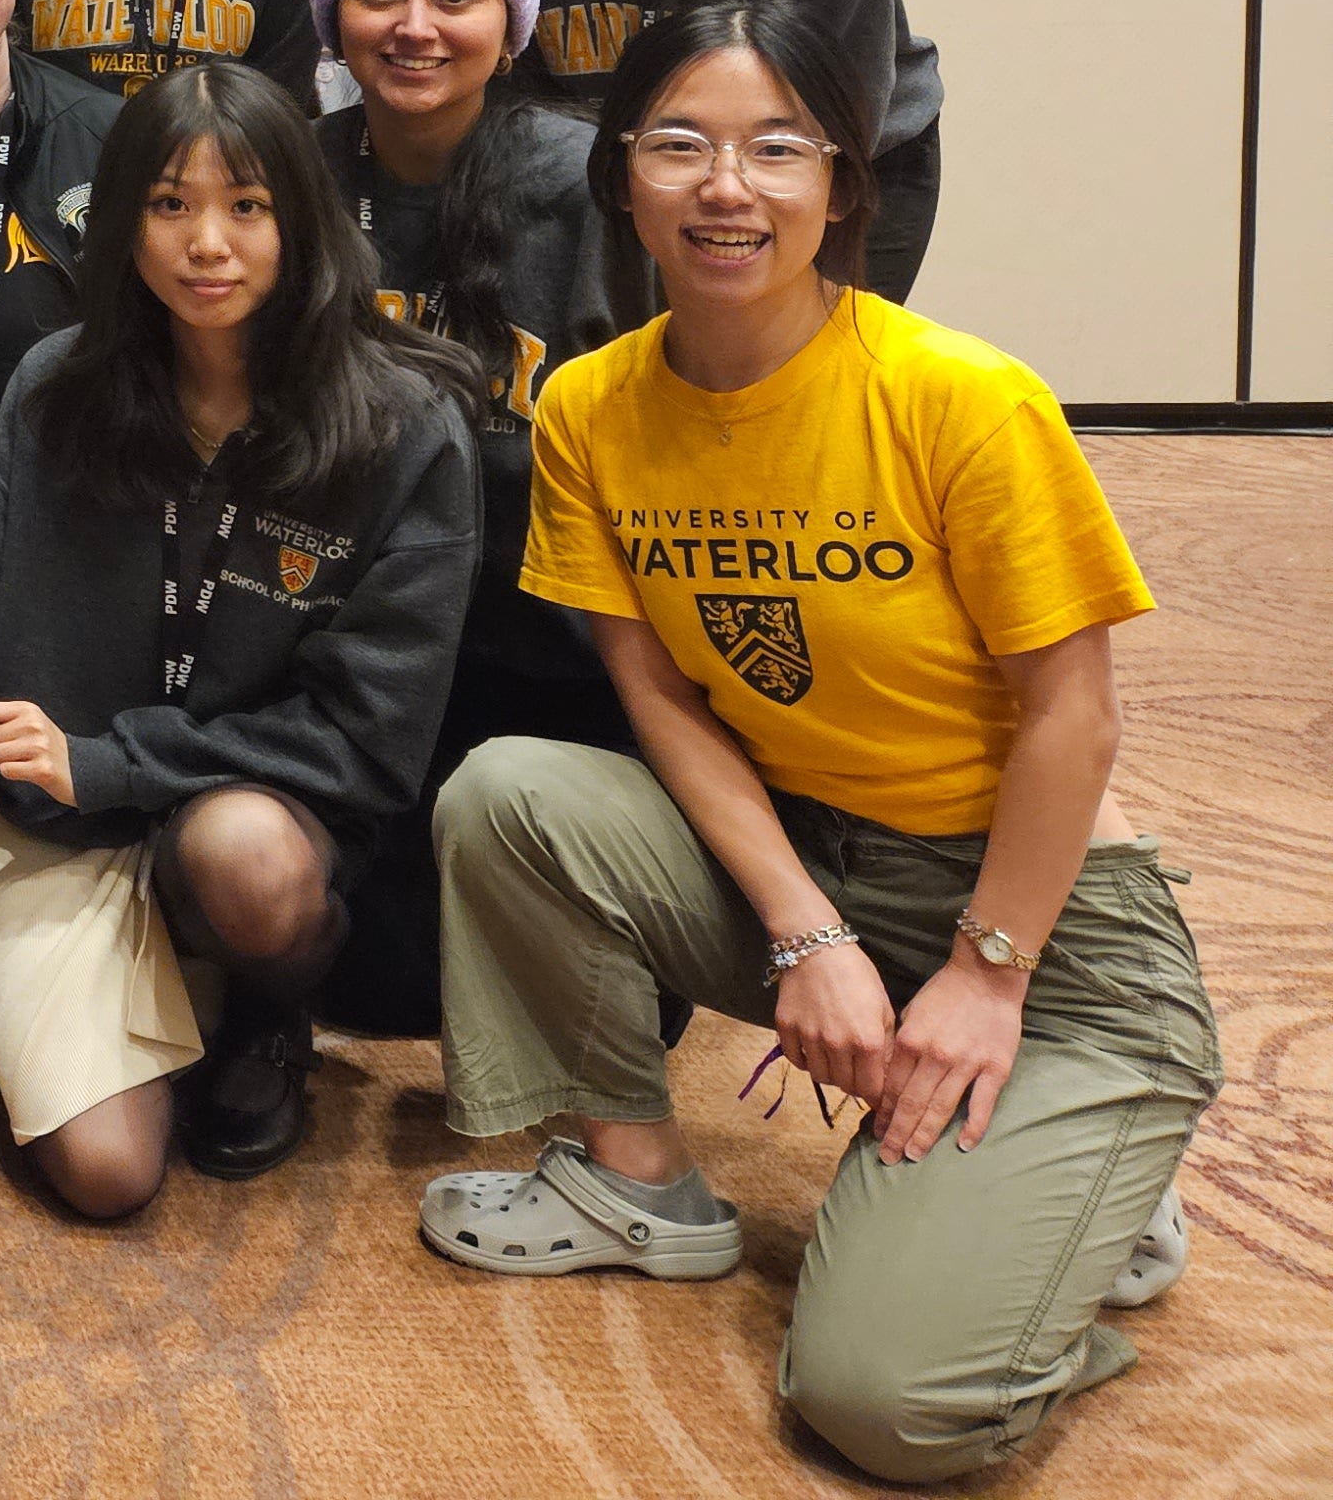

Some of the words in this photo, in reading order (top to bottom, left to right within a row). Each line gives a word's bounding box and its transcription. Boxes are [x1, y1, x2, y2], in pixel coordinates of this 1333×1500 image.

[171, 12, 182, 39] PDW
[361, 198, 372, 230] PDW
[165, 500, 177, 535] PDW
[218, 504, 237, 539] PDW
[264, 511, 331, 541] UNIVERSITY
[336, 537, 353, 546] OF
[609, 509, 809, 529] UNIVERSITY
[835, 510, 876, 531] OF
[165, 580, 177, 614] PDW
[196, 580, 215, 614] PDW
[220, 569, 270, 597] SCHOOL
[273, 590, 289, 604] OF
[176, 654, 194, 688] PDW
